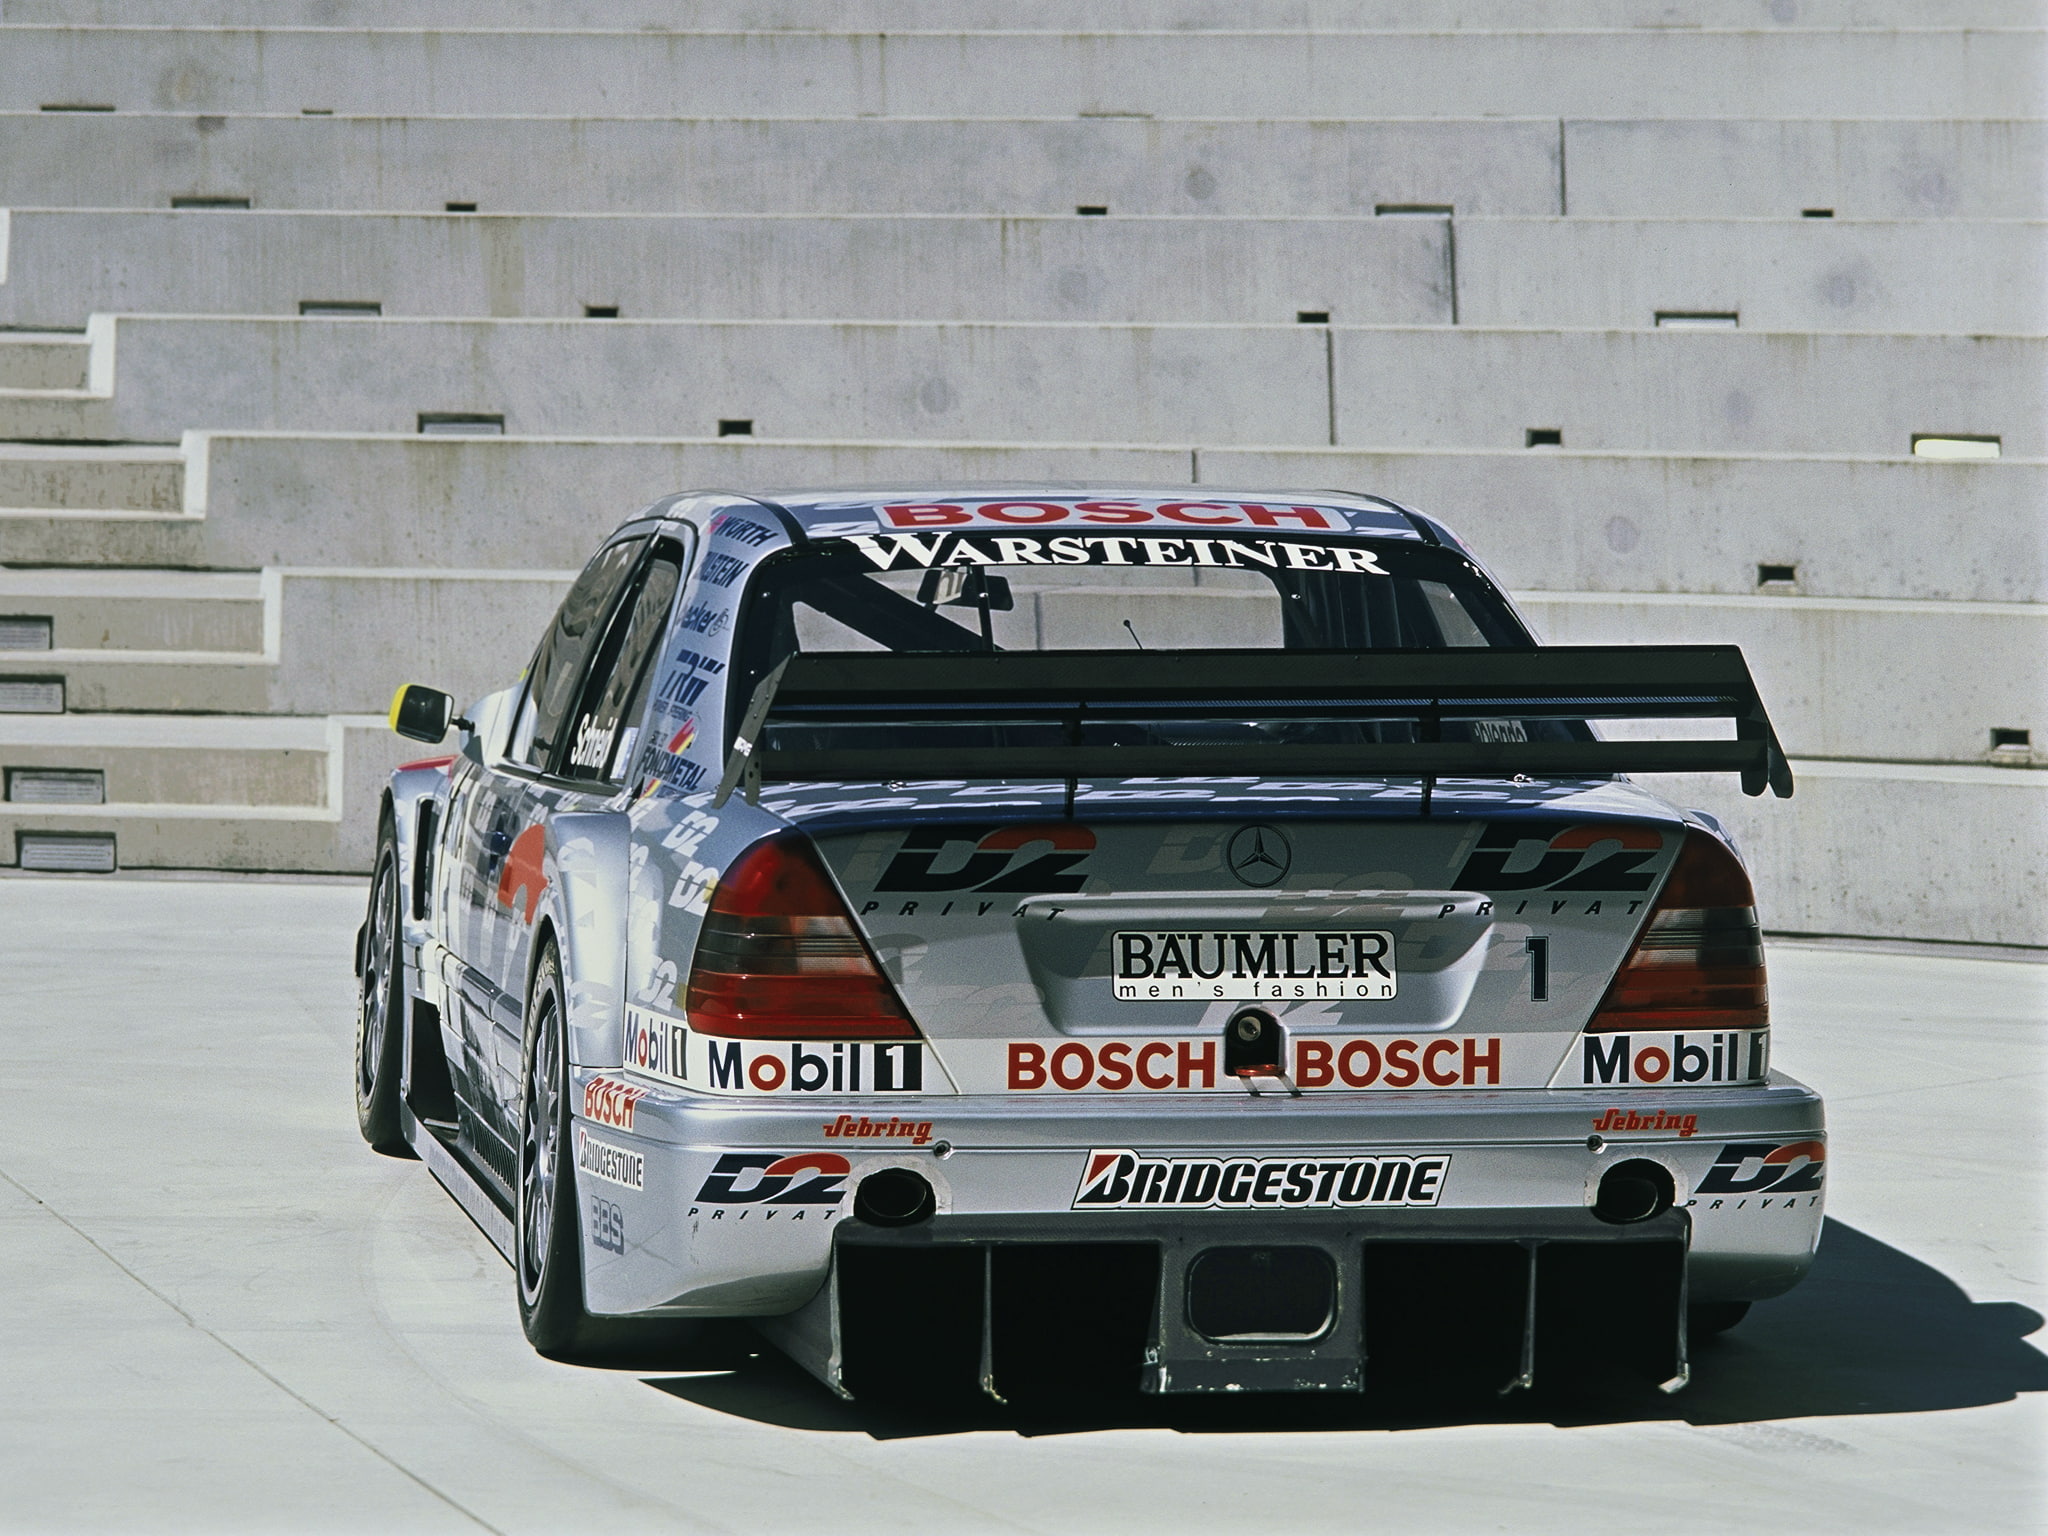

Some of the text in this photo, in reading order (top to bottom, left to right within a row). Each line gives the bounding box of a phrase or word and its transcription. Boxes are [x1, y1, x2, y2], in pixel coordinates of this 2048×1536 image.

[883, 502, 1333, 529] BOSCH
[842, 531, 1391, 576] WARSTEINER
[873, 823, 1098, 894] D2
[1449, 822, 1665, 893] D2
[860, 900, 1066, 921] PRIVAT
[1437, 899, 1646, 919] PRIVAT
[1117, 932, 1393, 981] BÄUMLER
[1526, 935, 1549, 1001] 1
[1254, 979, 1393, 998] fashion
[624, 1010, 669, 1075] Mobil
[708, 1041, 860, 1092] Mobil
[1007, 1040, 1216, 1091] BOSCH
[1296, 1038, 1501, 1088] BOSCH
[1584, 1033, 1739, 1084] Mobil
[584, 1076, 649, 1129] BOSCH
[1592, 1107, 1699, 1138] Sebring
[823, 1114, 933, 1144] Sebring
[579, 1131, 643, 1188] BRIDGESTONE
[694, 1151, 853, 1205] D2
[1074, 1151, 1449, 1207] BRIDGESTONE
[1694, 1140, 1826, 1194] D2
[687, 1207, 838, 1221] PRIVAT
[1686, 1195, 1819, 1210] PRIVAT
